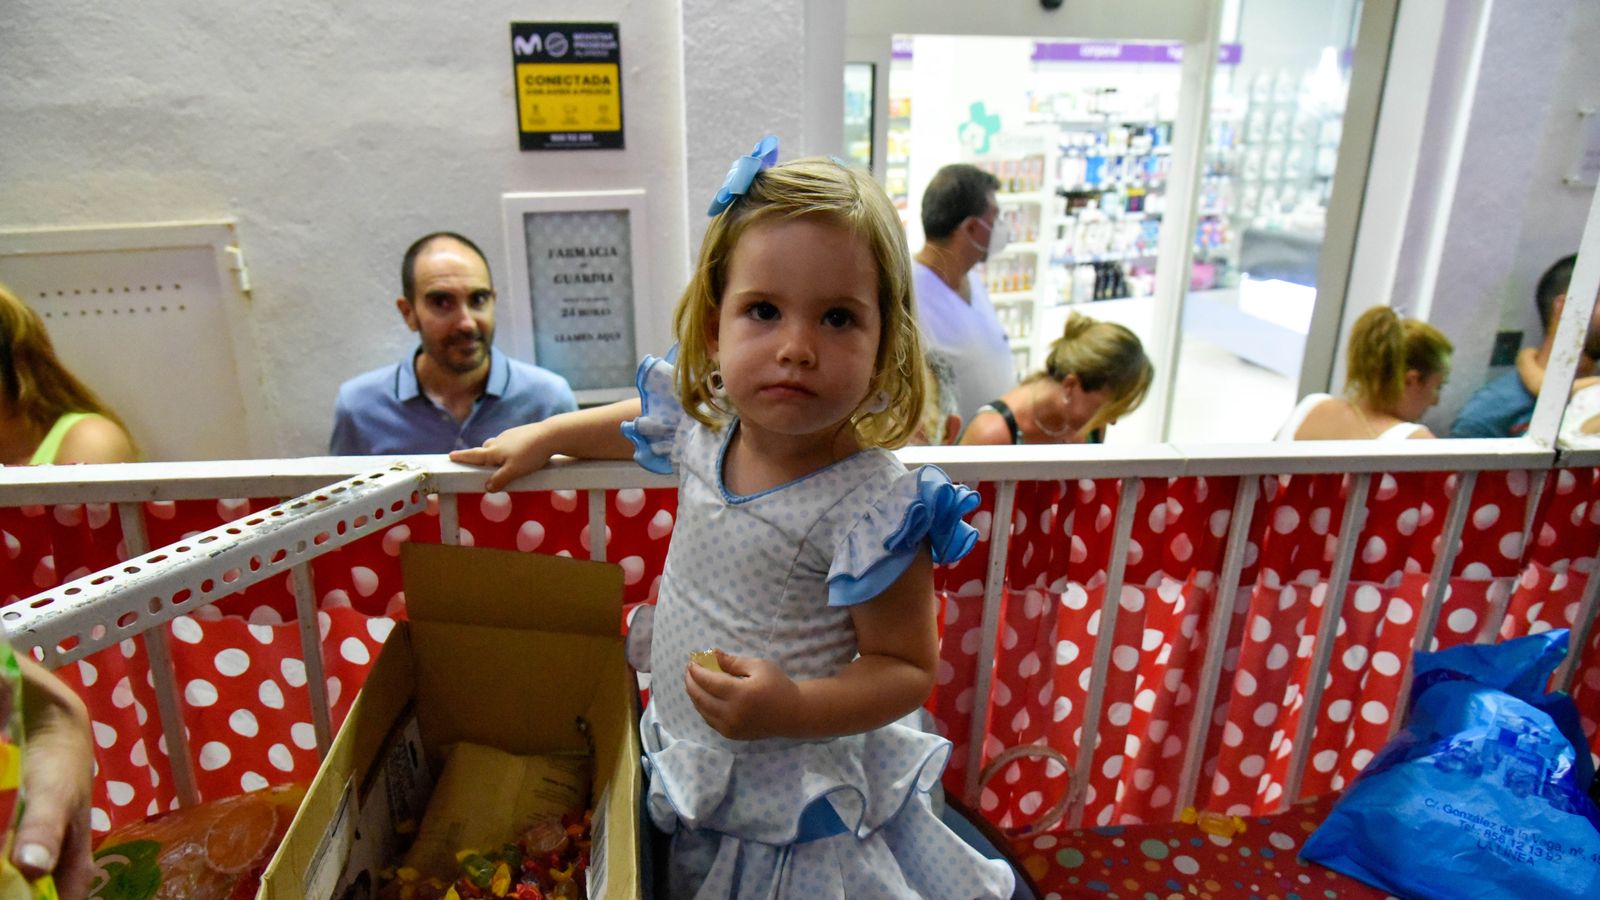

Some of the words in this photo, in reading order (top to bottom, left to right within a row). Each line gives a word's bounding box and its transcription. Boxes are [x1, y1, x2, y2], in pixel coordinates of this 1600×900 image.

[525, 74, 611, 86] CONECTADA
[548, 246, 617, 259] FARMACIA
[553, 273, 614, 284] GUARDIA
[1499, 824, 1515, 836] de
[1483, 829, 1506, 845] 856
[1510, 839, 1525, 851] 12
[1529, 845, 1543, 857] 13
[1545, 851, 1563, 864] 92
